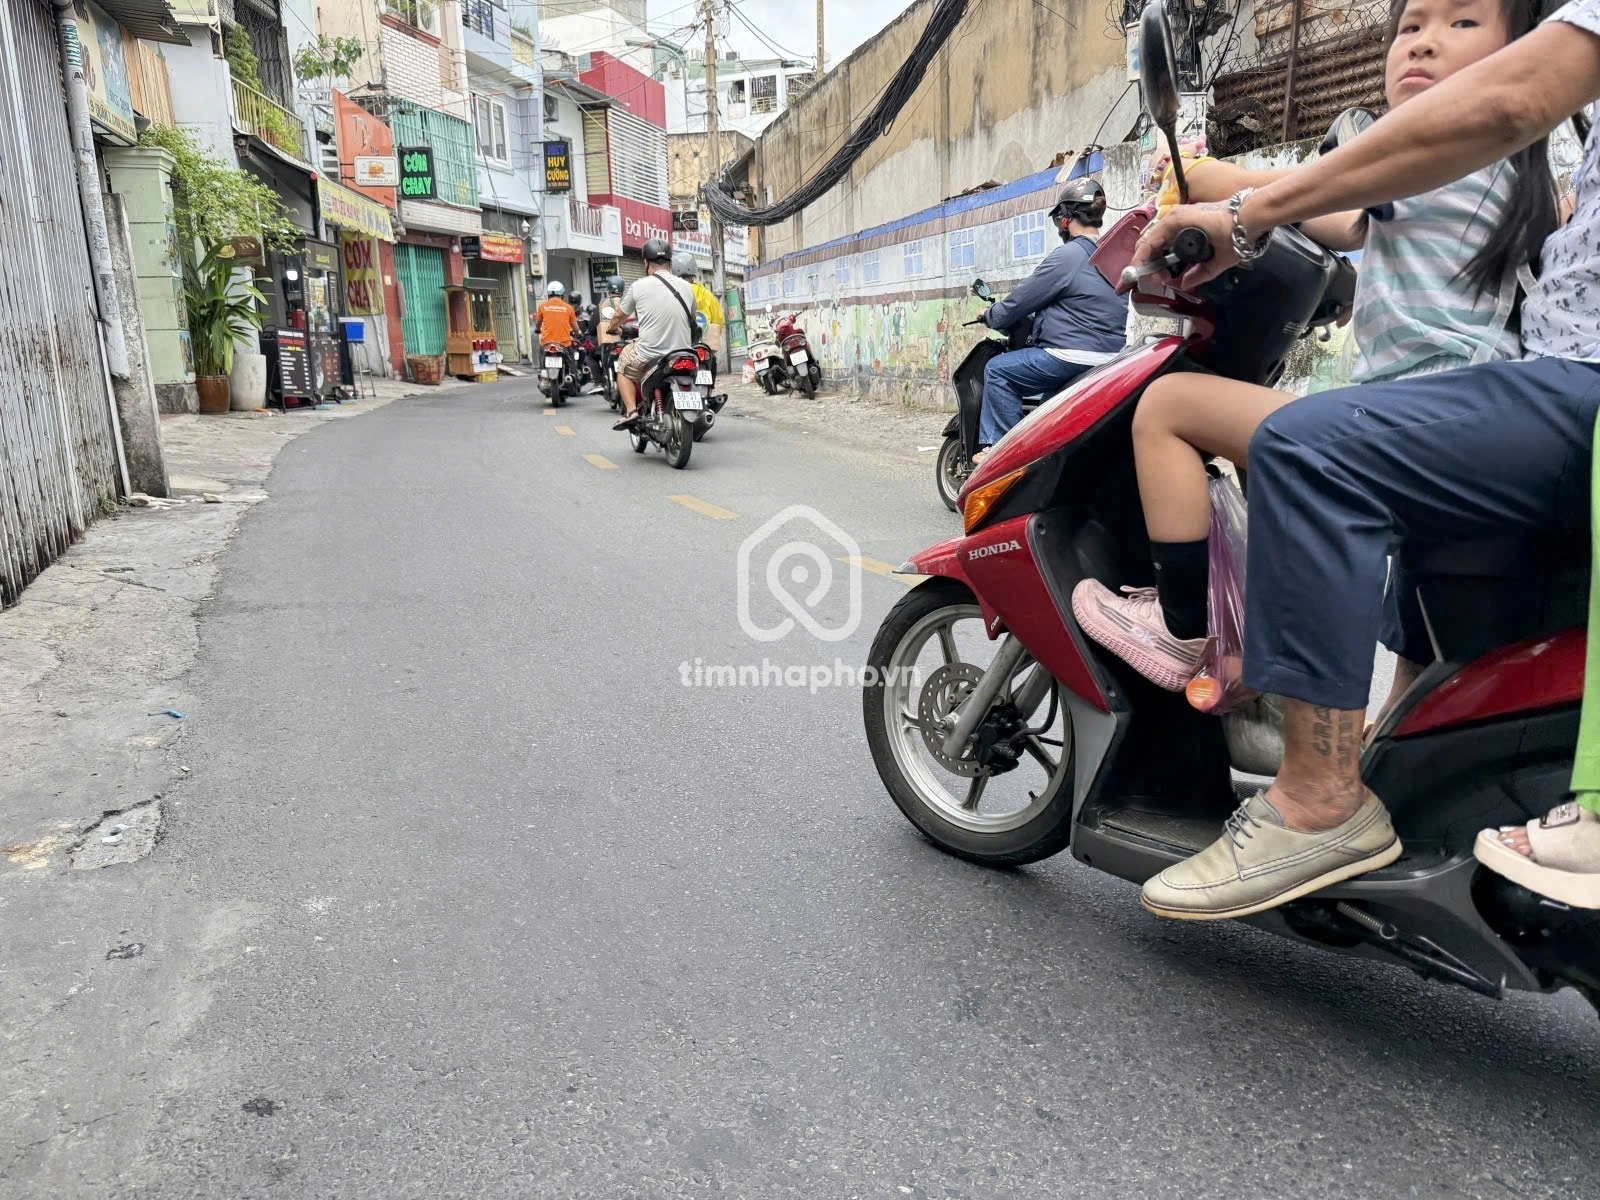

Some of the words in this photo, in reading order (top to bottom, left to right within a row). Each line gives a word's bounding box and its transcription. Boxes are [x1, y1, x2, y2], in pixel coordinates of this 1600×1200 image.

[547, 156, 566, 167] HUY
[402, 177, 432, 195] CHAY
[625, 217, 641, 240] Đại
[348, 279, 377, 308] CHAY
[968, 540, 1022, 560] HONDA
